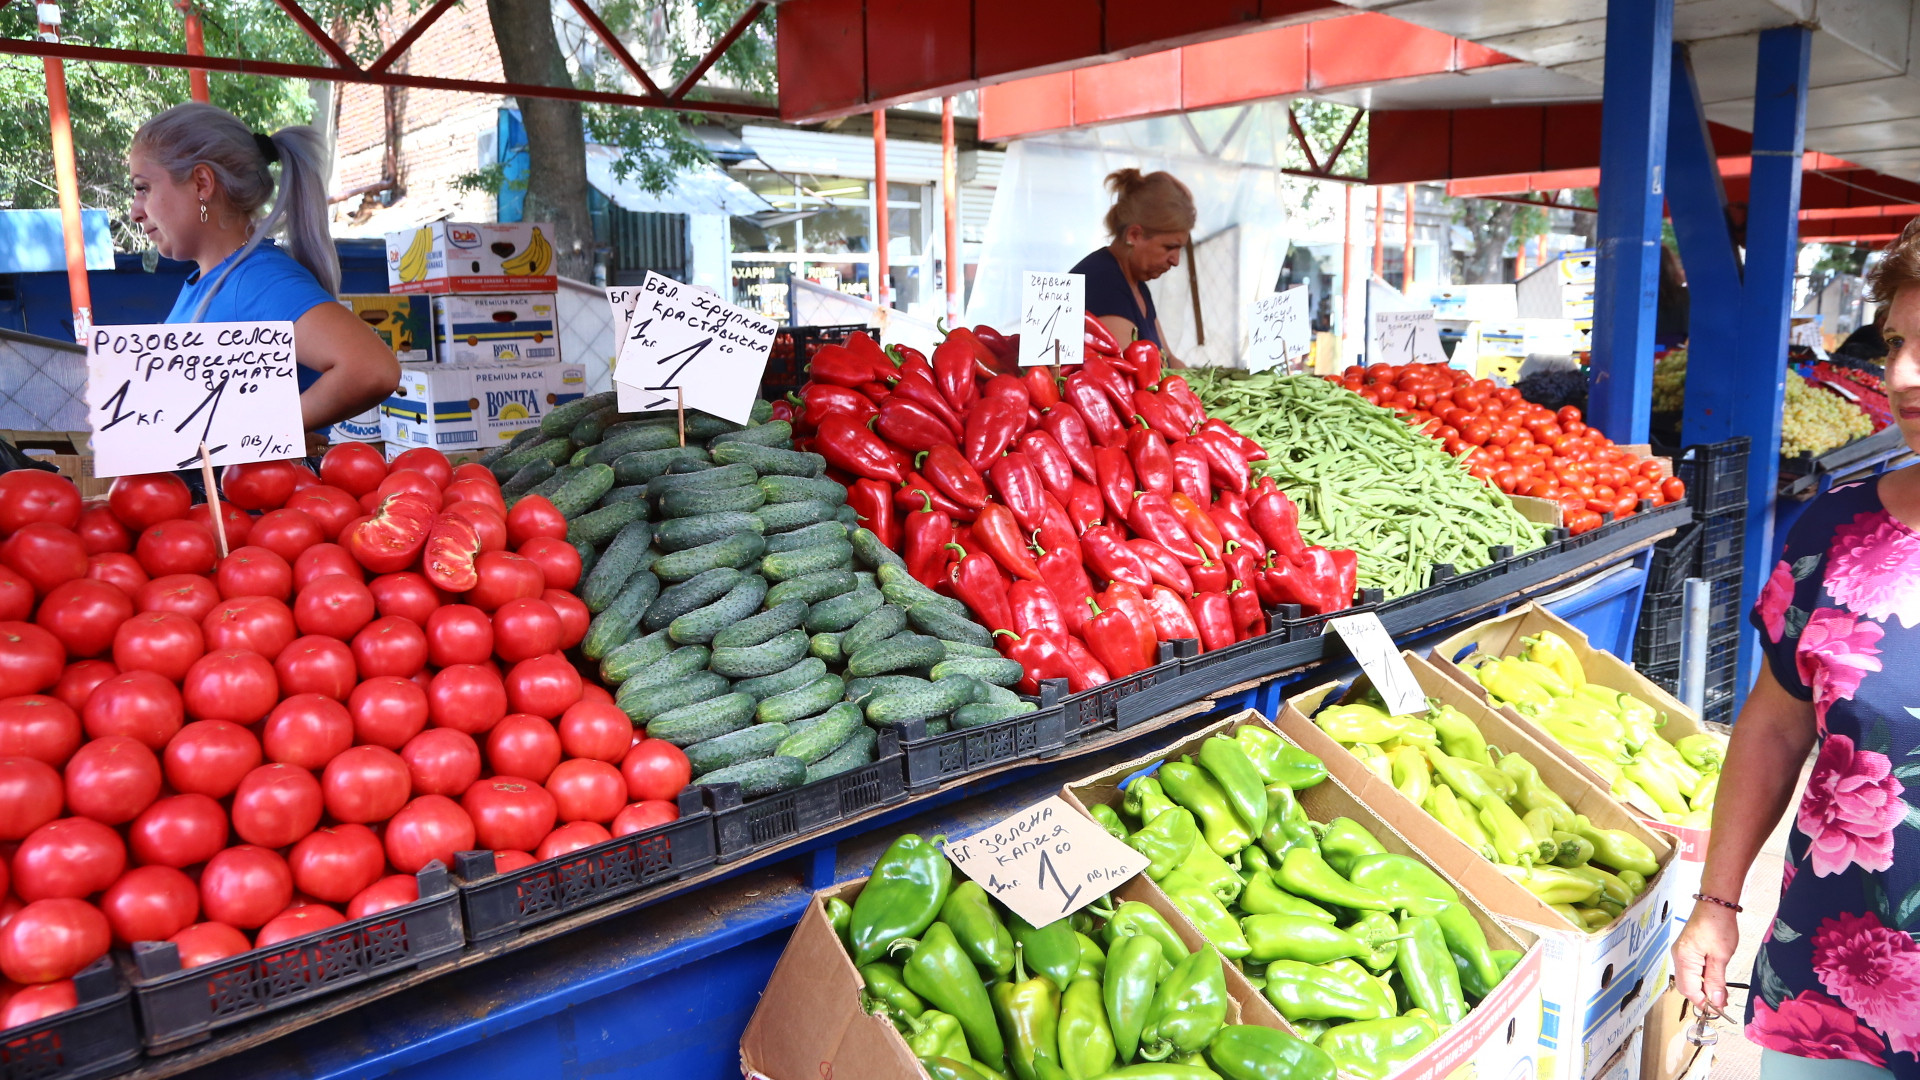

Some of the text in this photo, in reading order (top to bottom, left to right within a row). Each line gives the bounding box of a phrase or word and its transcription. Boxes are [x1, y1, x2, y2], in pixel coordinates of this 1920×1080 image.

[453, 229, 477, 240] Dole
[732, 267, 775, 279] АХАРНИ
[1038, 304, 1062, 358] 1
[493, 344, 520, 358] BONITA
[644, 336, 734, 390] 1 60
[476, 371, 544, 382] PREMIUM PACK
[485, 389, 541, 418] BONITA
[174, 377, 258, 469] 1 60
[1038, 842, 1082, 914] 1 60
[1435, 1037, 1474, 1076] PREMIUM
